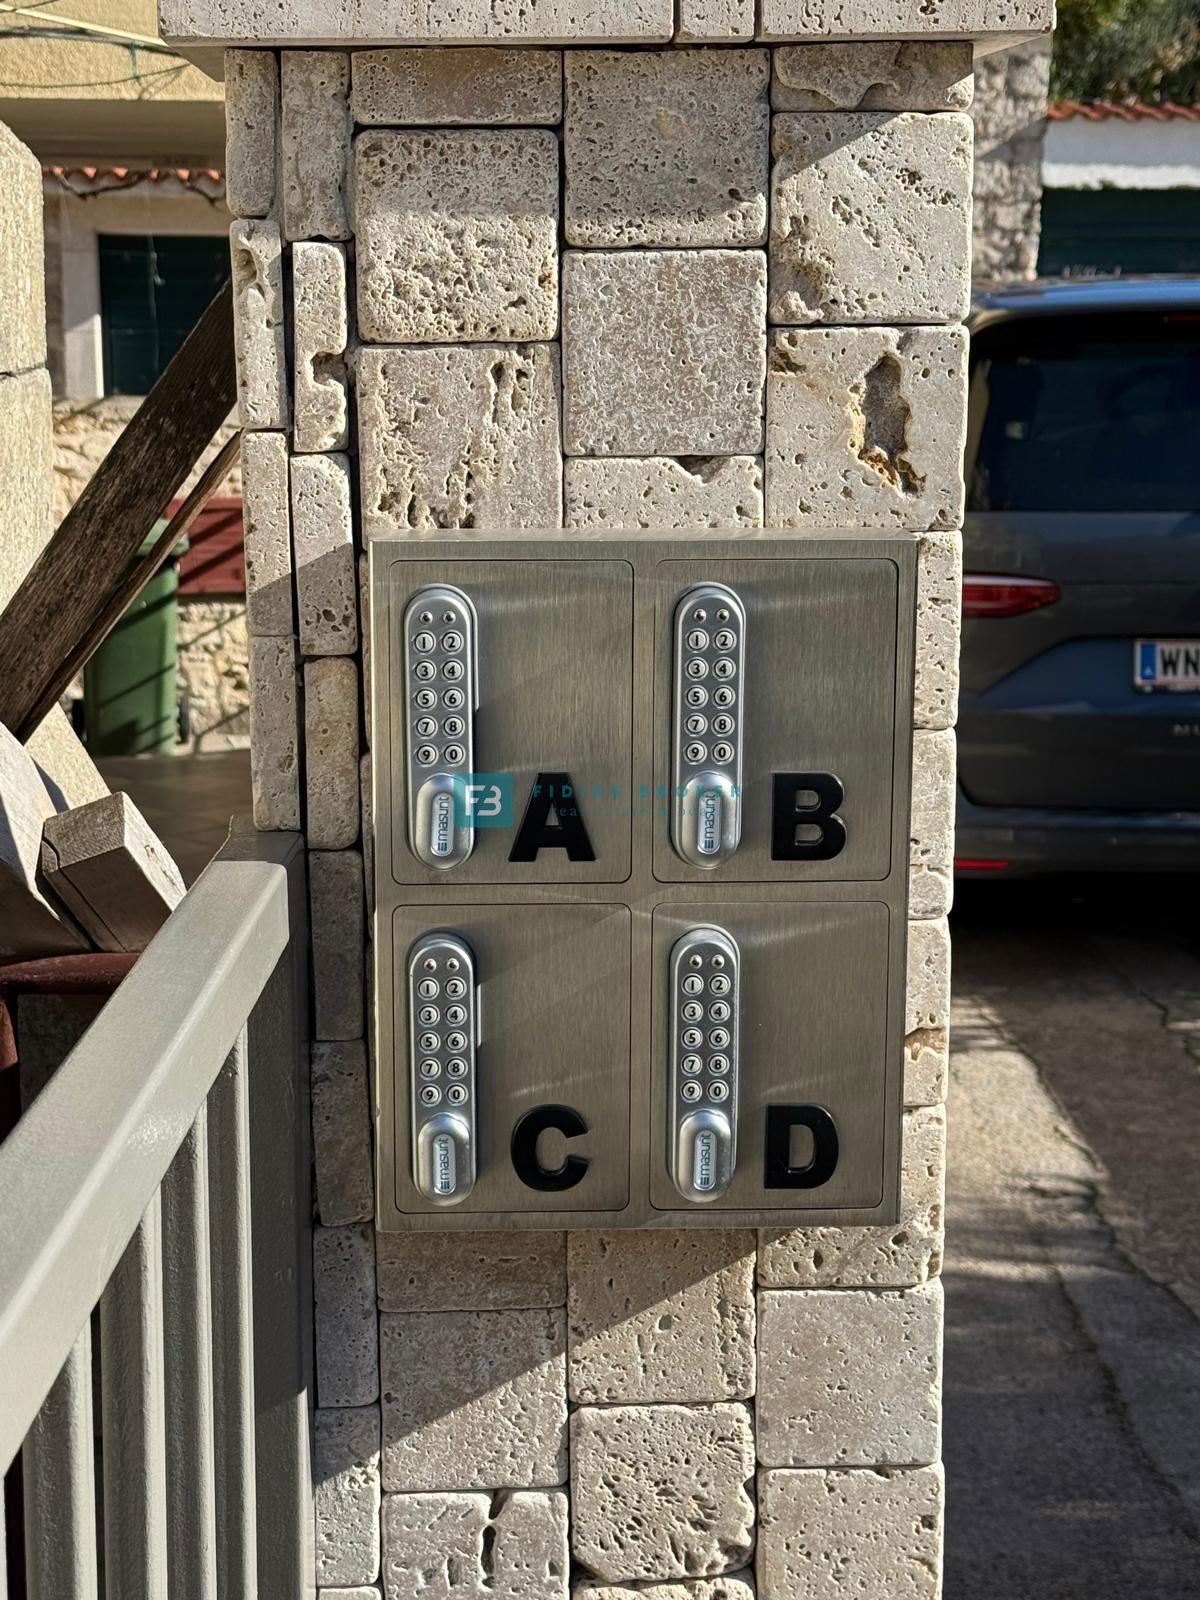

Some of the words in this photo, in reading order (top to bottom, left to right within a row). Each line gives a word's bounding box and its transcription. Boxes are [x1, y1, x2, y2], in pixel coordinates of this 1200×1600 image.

[447, 636, 456, 649] 2
[720, 634, 728, 647] 2
[420, 665, 429, 677] 3
[447, 665, 456, 677] 4
[692, 663, 700, 675] 3
[718, 663, 727, 675] 4
[421, 693, 429, 705] 5
[448, 693, 457, 705] 6
[692, 691, 700, 703] 5
[718, 691, 727, 703] 6
[422, 721, 430, 733] 7
[449, 721, 457, 733] 8
[691, 719, 700, 731] 7
[718, 719, 727, 731] 8
[422, 749, 430, 761] 9
[449, 749, 458, 760] 0
[690, 747, 699, 758] 9
[717, 747, 726, 759] 0
[509, 772, 597, 862] A
[771, 772, 848, 861] B
[450, 982, 459, 994] 2
[715, 979, 723, 991] 2
[423, 1010, 432, 1022] 3
[450, 1009, 459, 1021] 4
[688, 1006, 696, 1018] 3
[713, 1006, 722, 1017] 4
[424, 1036, 433, 1048] 5
[451, 1036, 459, 1047] 6
[687, 1033, 696, 1044] 5
[714, 1033, 722, 1044] 6
[424, 1063, 433, 1075] 7
[451, 1062, 460, 1074] 8
[688, 1059, 696, 1071] 7
[713, 1059, 722, 1070] 8
[425, 1090, 434, 1101] 9
[451, 1089, 460, 1100] 0
[687, 1086, 695, 1097] 9
[713, 1086, 721, 1097] 0
[511, 1104, 589, 1192] C
[764, 1104, 839, 1190] D
